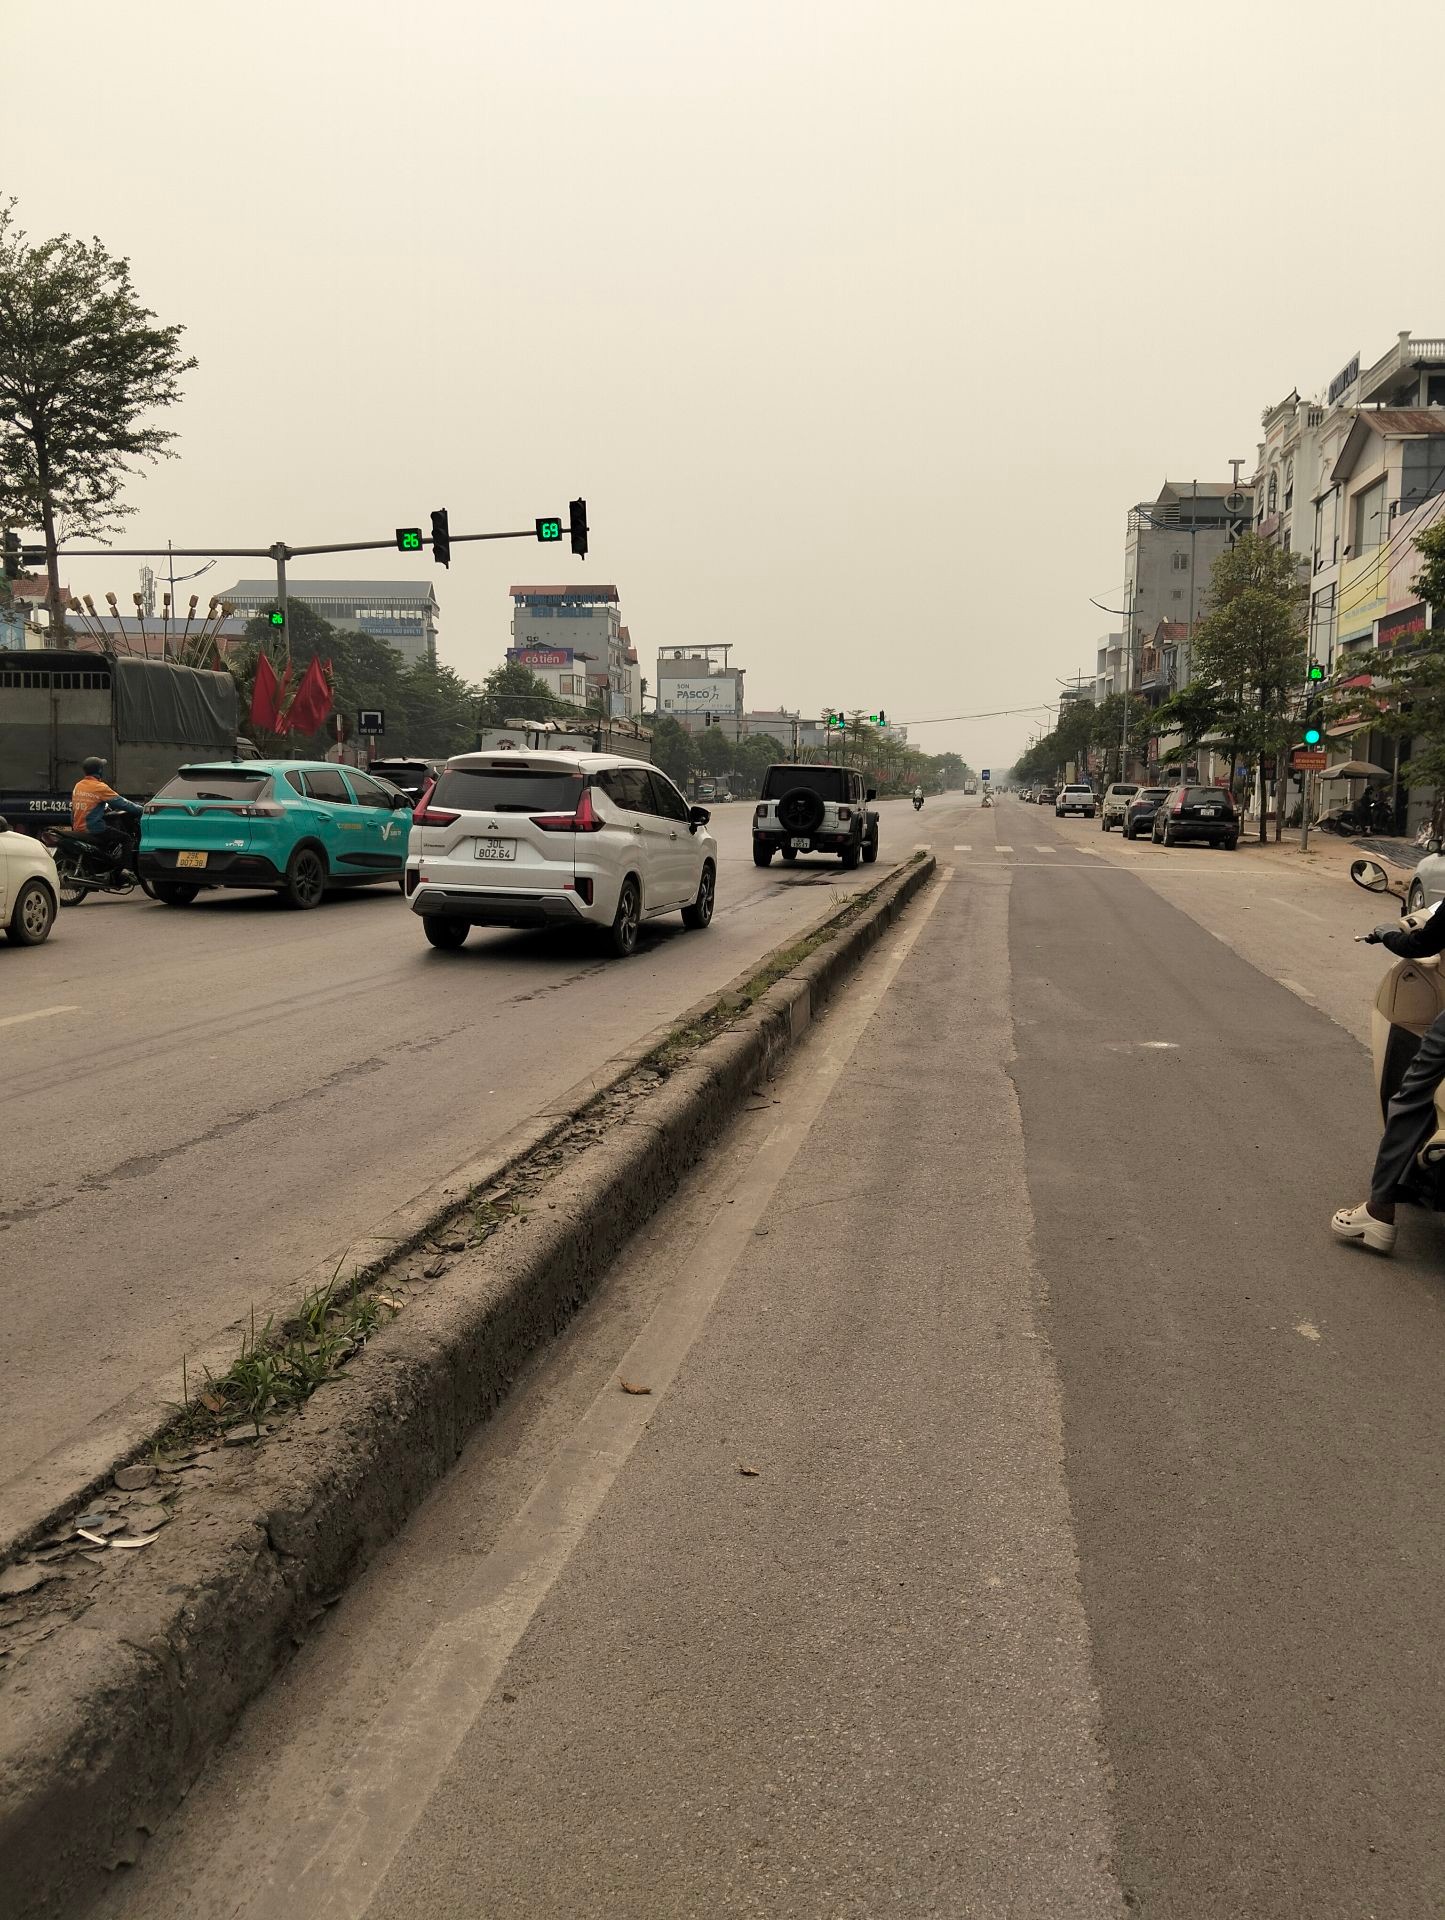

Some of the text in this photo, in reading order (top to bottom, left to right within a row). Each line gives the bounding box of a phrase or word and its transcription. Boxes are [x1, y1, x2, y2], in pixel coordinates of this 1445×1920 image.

[542, 523, 559, 538] 69
[403, 533, 419, 548] 26
[525, 654, 539, 664] có
[677, 691, 710, 699] PASCO
[487, 839, 504, 848] 30L
[479, 849, 510, 858] 802.64
